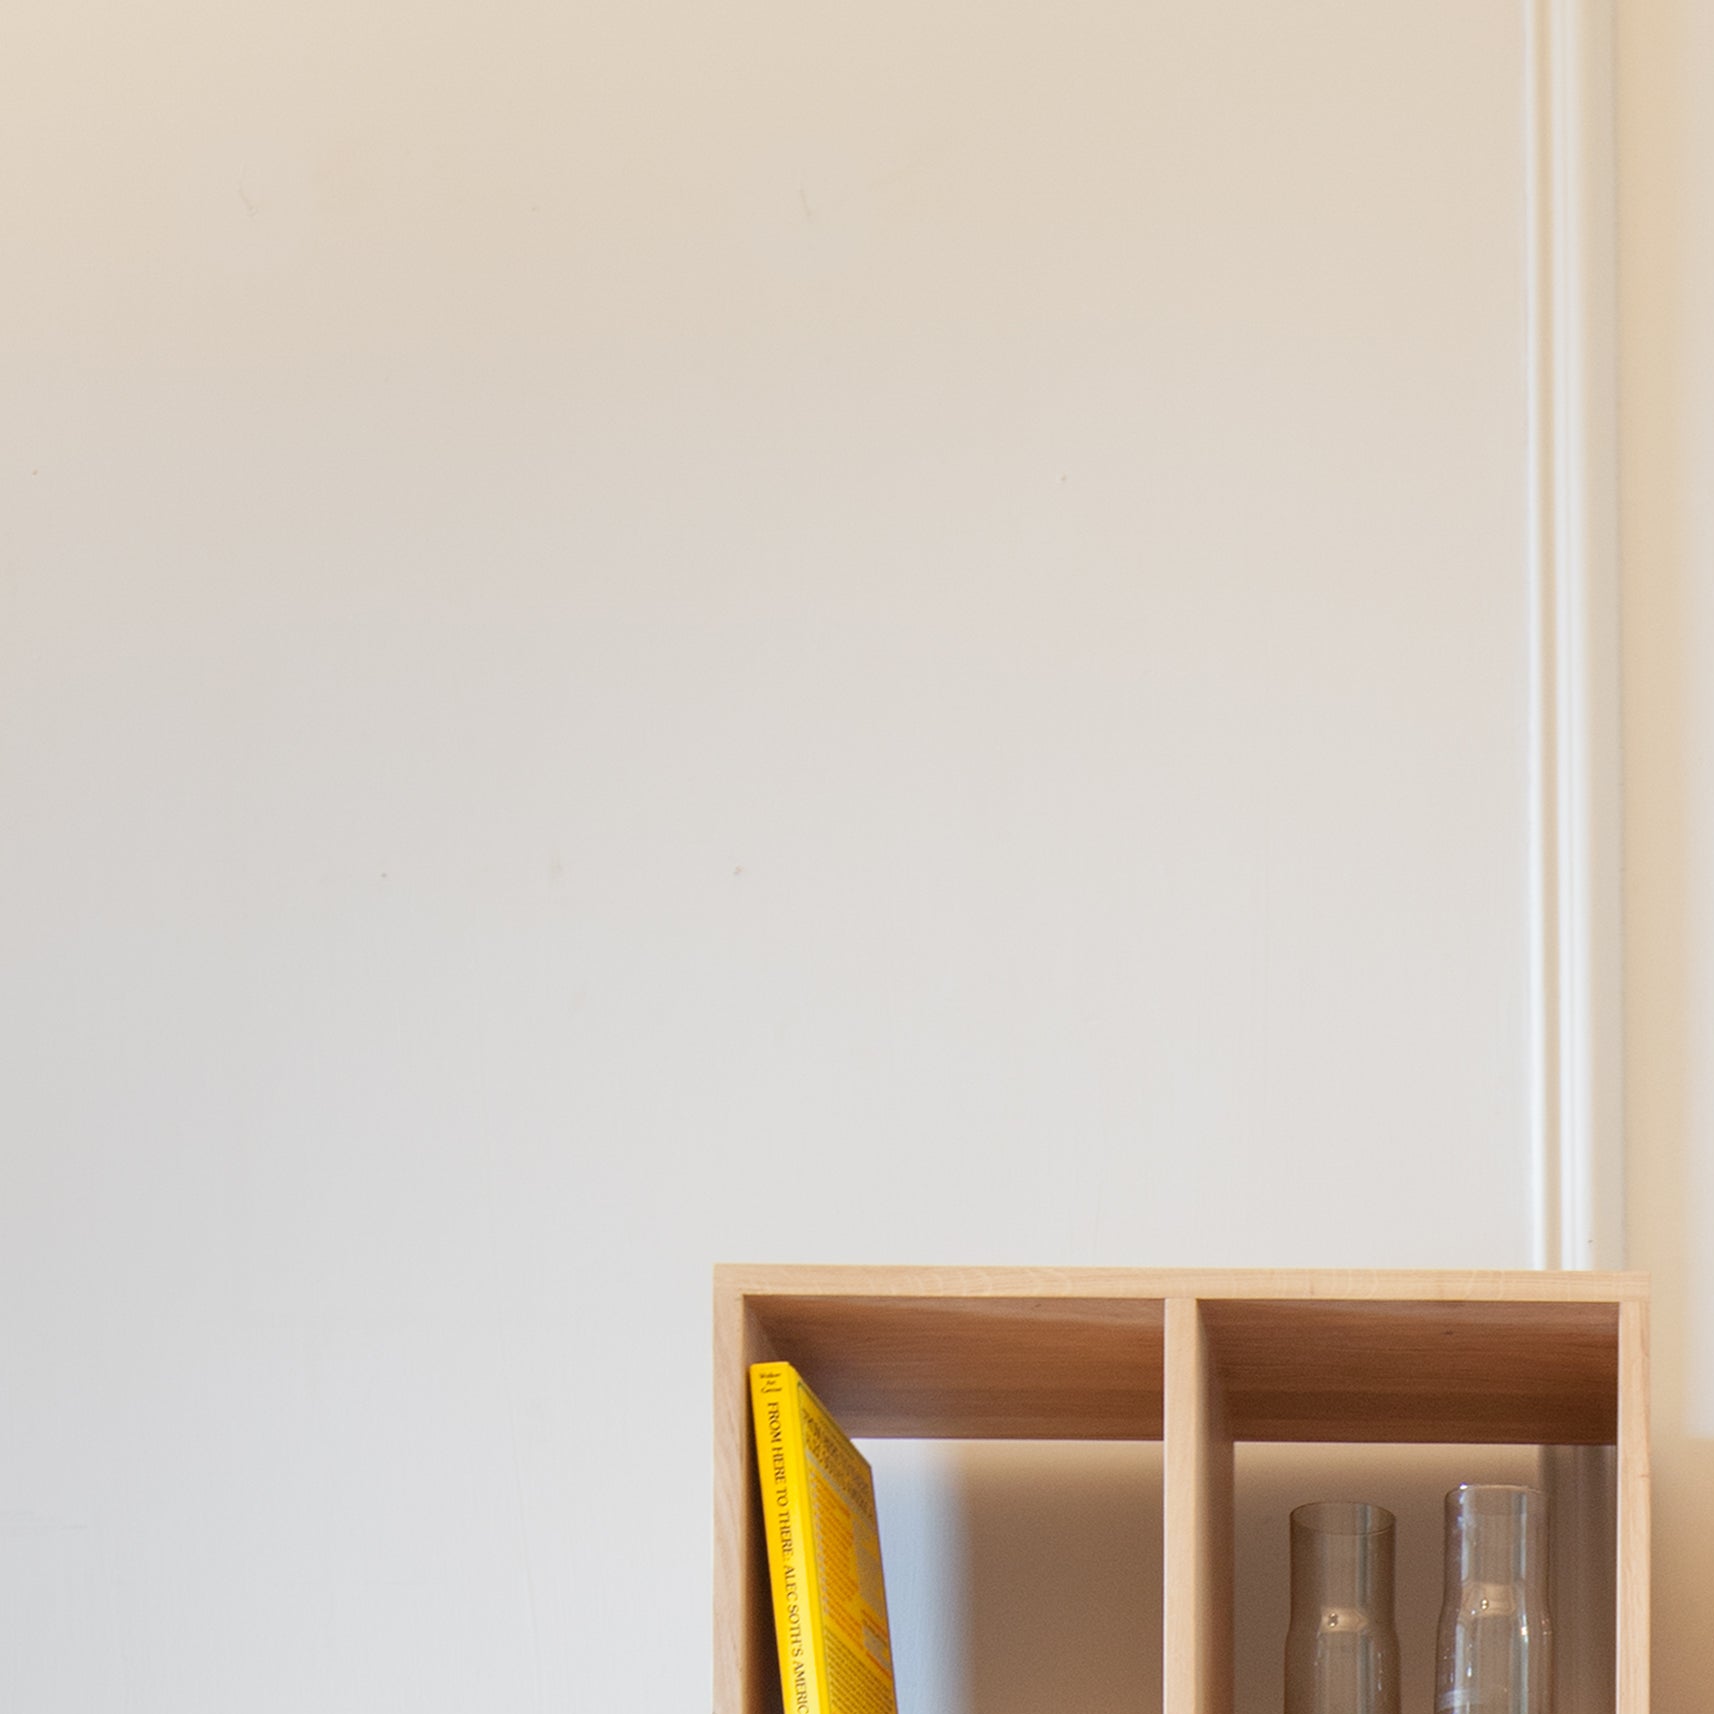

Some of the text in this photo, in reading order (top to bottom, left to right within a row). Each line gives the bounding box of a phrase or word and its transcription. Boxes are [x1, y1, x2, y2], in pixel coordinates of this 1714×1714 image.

[766, 1401, 782, 1440] FROM
[770, 1443, 787, 1485] HERE
[775, 1487, 789, 1513] TO
[785, 1565, 799, 1602] ALEC
[788, 1604, 805, 1657] SOTH'S
